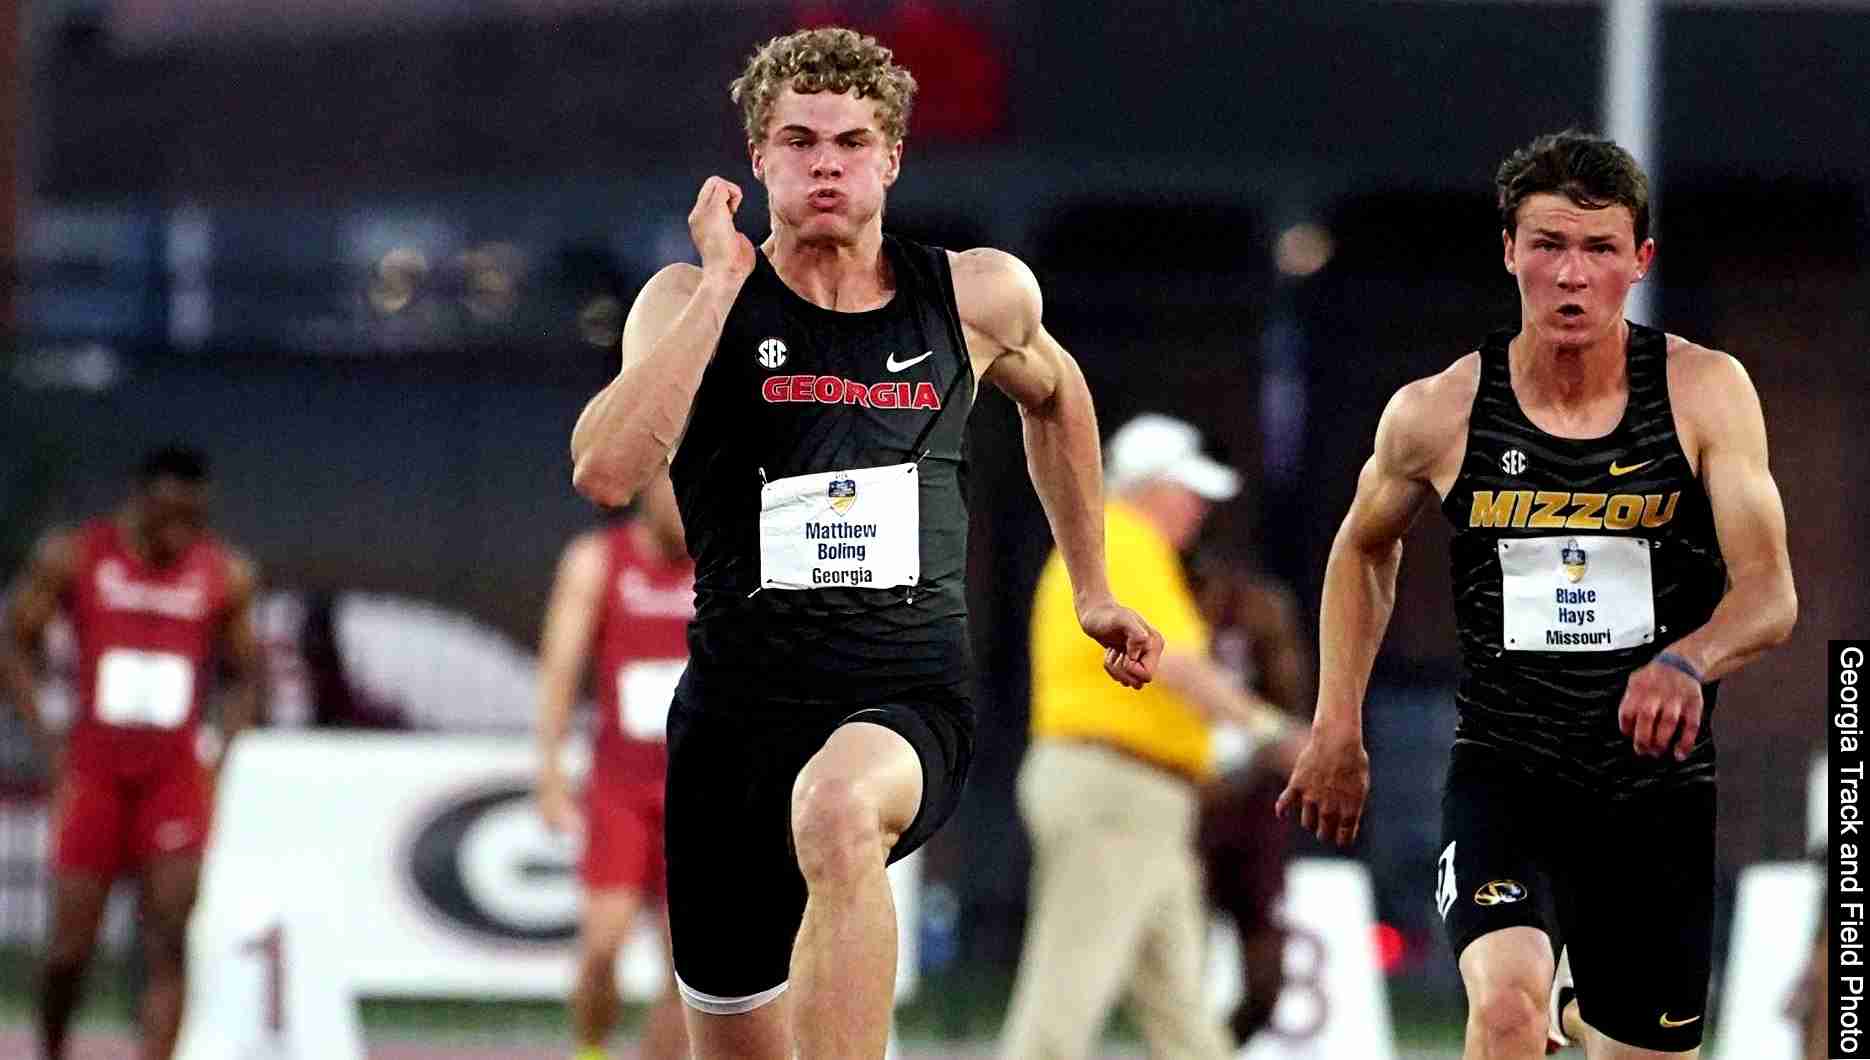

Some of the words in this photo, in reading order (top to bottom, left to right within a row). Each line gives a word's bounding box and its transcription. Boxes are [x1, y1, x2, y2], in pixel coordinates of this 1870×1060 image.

[758, 339, 787, 368] SEC
[762, 376, 941, 410] GEORGIA
[1502, 450, 1527, 475] SEC
[1469, 490, 1681, 530] MIZZOU
[805, 522, 877, 540] Matthew
[817, 543, 866, 561] Boling
[812, 567, 873, 586] Georgia
[1556, 588, 1596, 604] Blake
[1559, 607, 1595, 626] Hays
[1546, 628, 1612, 645] Missouri
[240, 926, 288, 1037] 1
